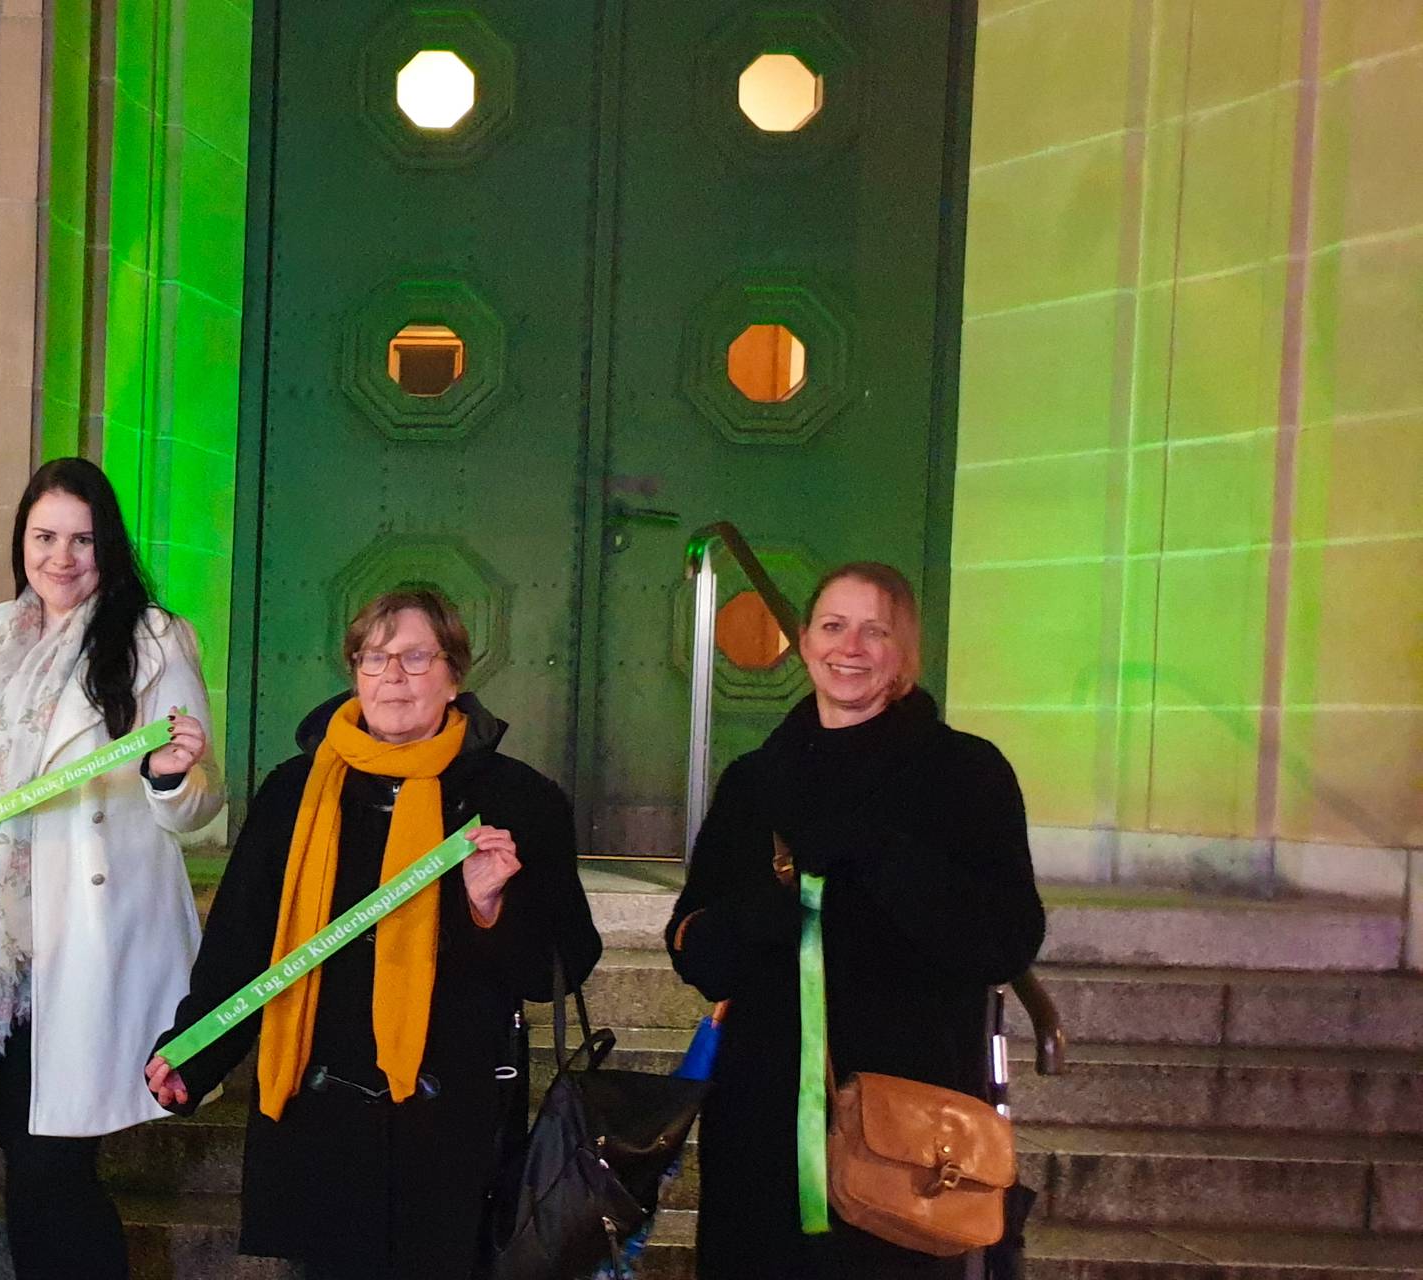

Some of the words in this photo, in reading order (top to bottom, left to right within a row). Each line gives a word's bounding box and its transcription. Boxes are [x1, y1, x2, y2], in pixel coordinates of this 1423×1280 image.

[20, 735, 148, 802] Kinderhospizarbeit
[250, 975, 285, 998] Tag
[283, 955, 308, 978] der
[307, 855, 444, 958] Kinderhospizarbeit
